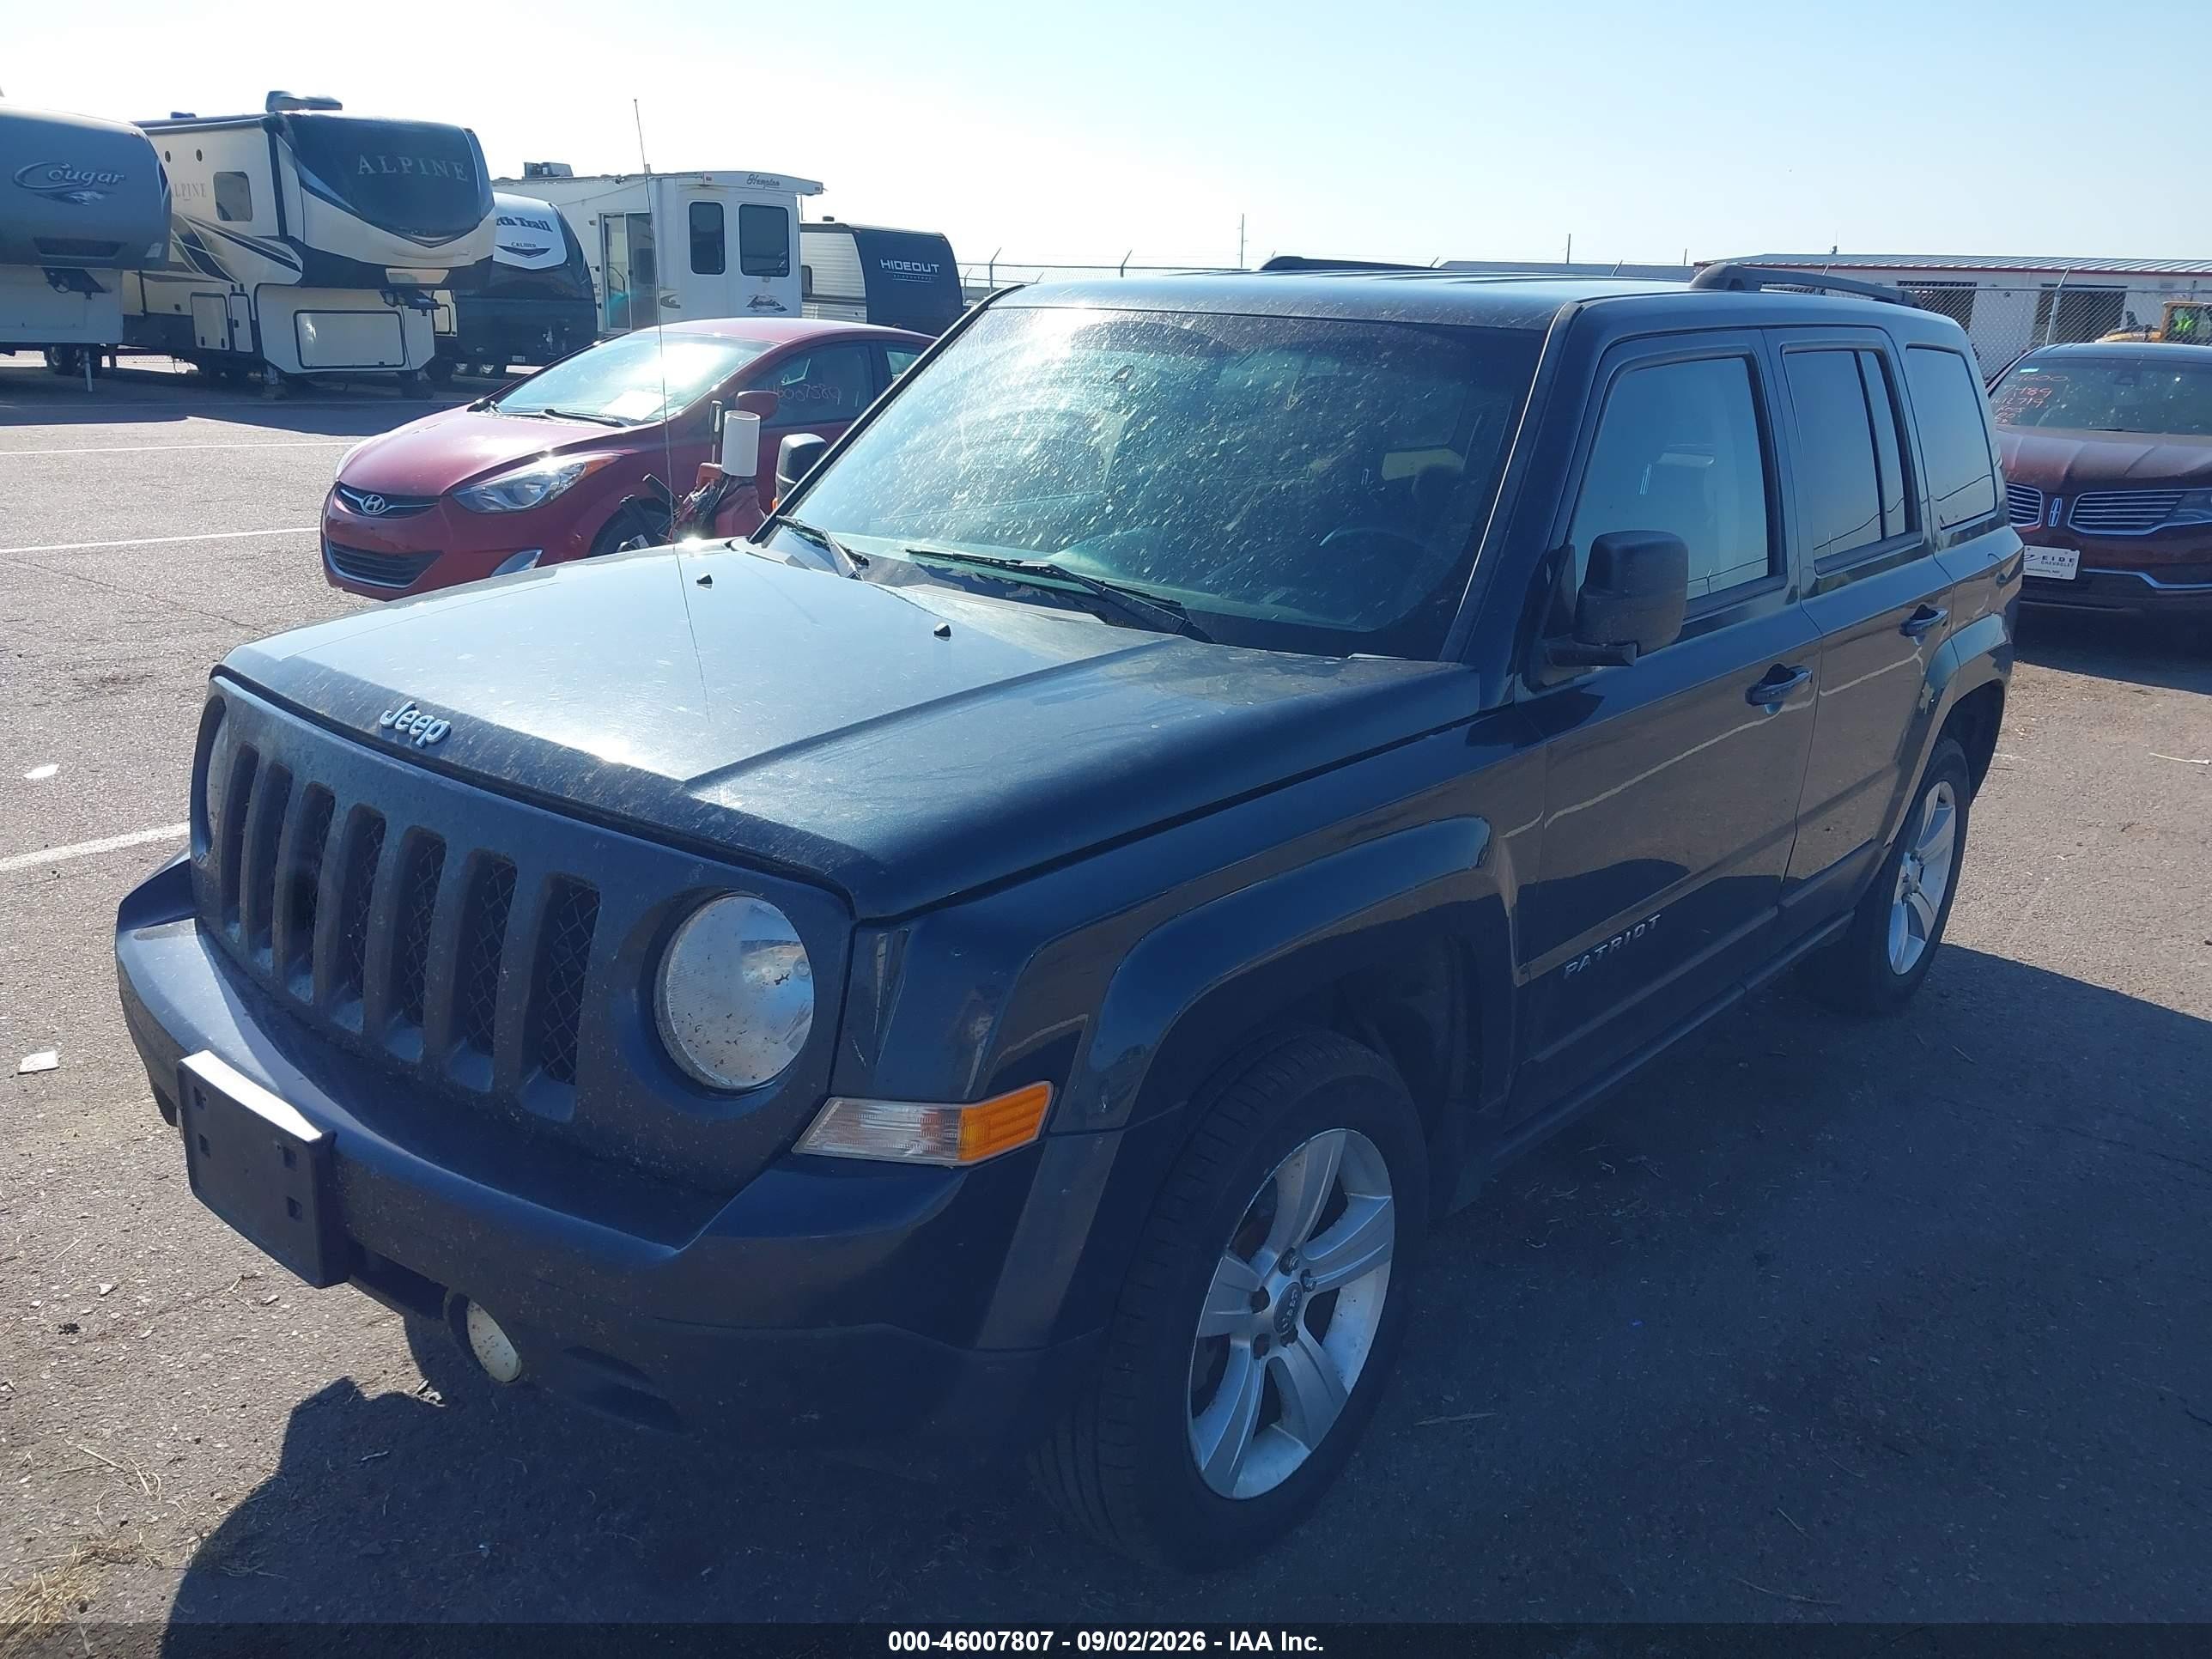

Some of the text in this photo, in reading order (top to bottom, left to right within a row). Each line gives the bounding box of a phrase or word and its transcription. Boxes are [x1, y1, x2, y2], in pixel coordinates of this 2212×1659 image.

[14, 160, 125, 190] Cougar
[357, 154, 469, 182] ALPINE
[173, 182, 207, 198] LPINE
[515, 216, 553, 233] Trail
[880, 258, 939, 273] HIDEOUT
[2042, 555, 2075, 563] EIDE
[379, 700, 451, 749] Jeep
[1564, 914, 1661, 980] PATRIOT
